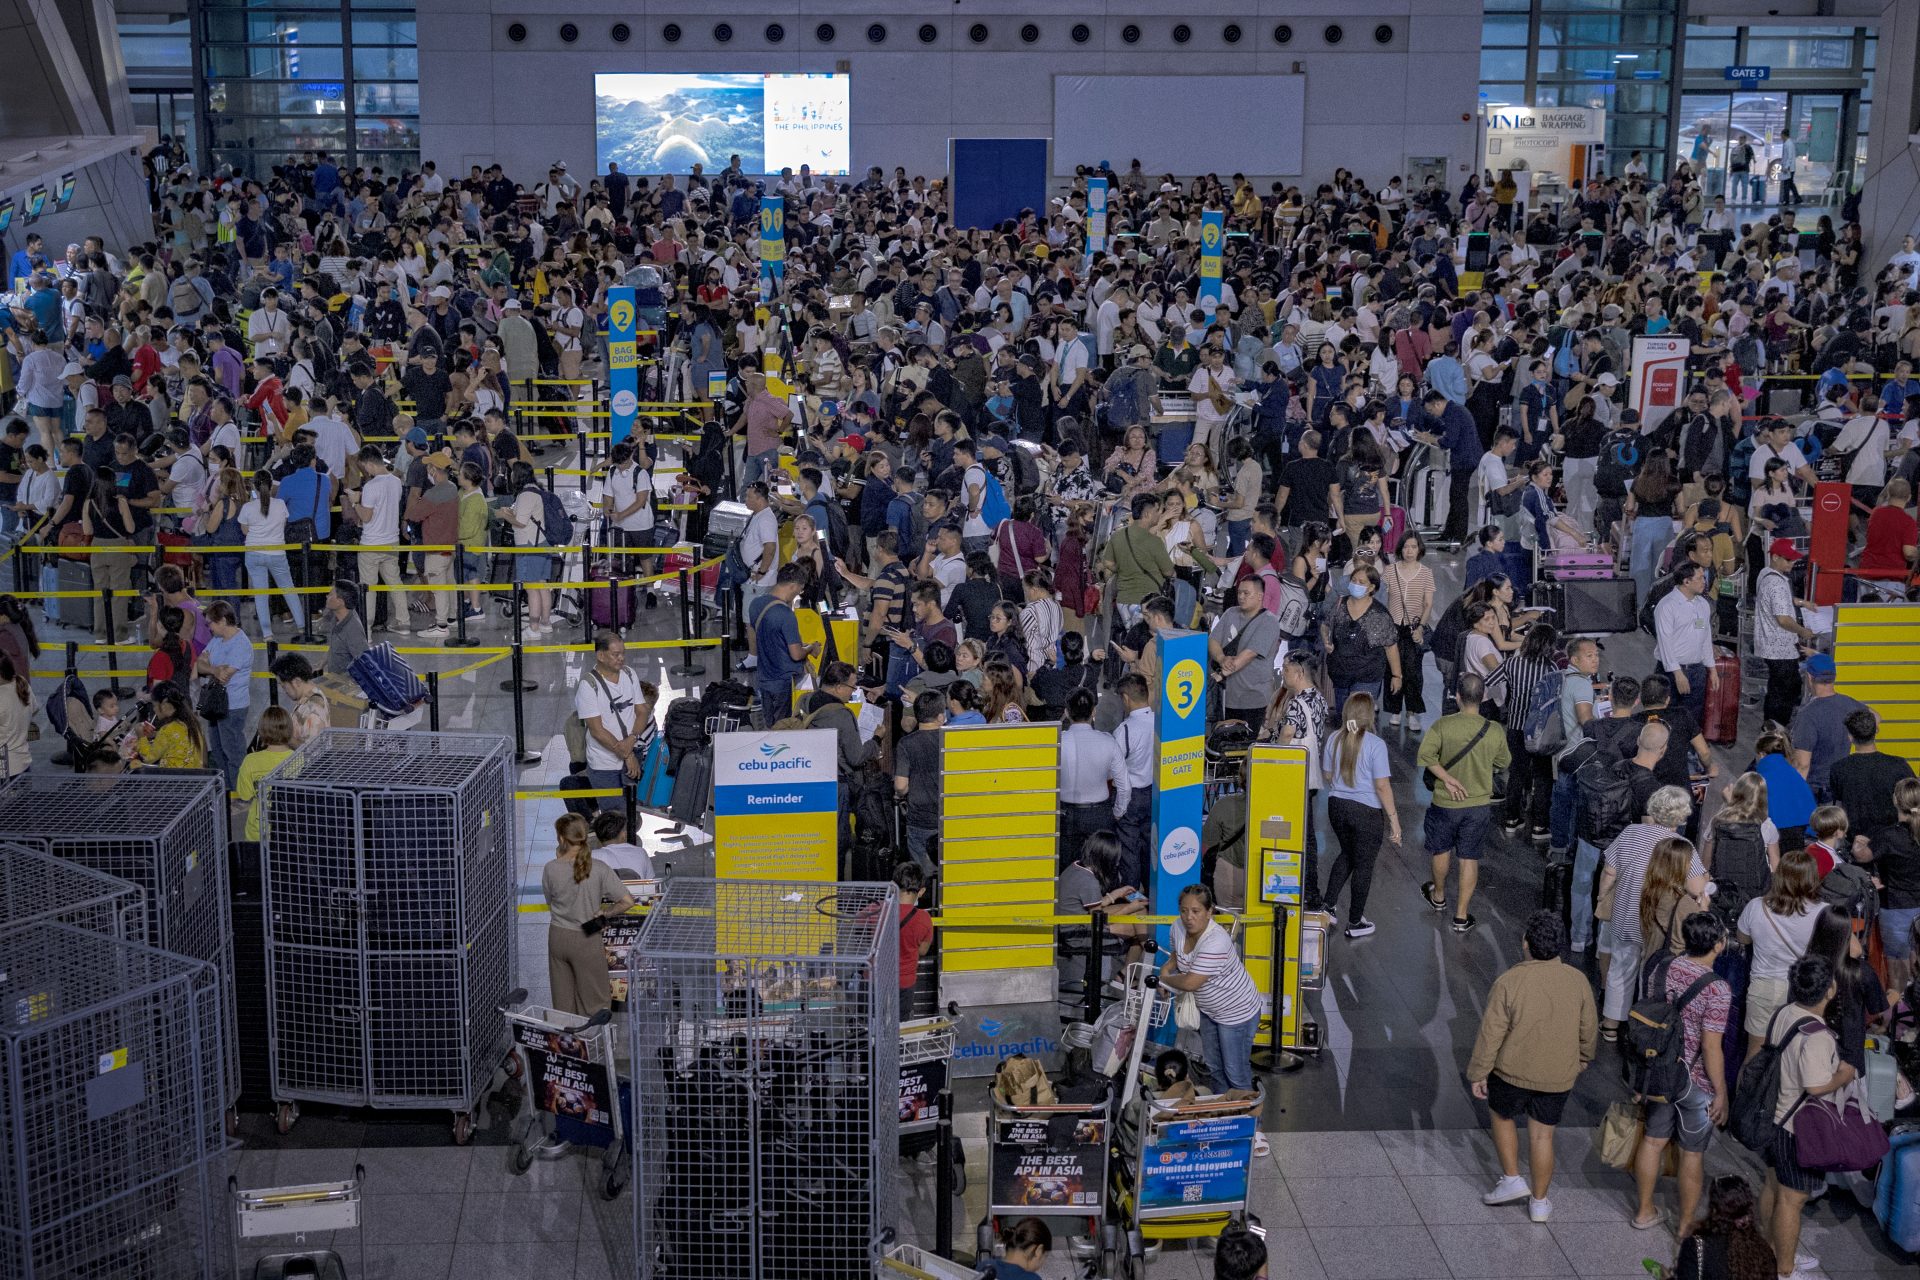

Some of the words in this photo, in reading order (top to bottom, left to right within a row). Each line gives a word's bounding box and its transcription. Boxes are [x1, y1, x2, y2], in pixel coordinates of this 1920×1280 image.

[1731, 68, 1756, 78] GATE
[1758, 68, 1765, 78] 3
[1542, 114, 1586, 122] BAGGAGE
[775, 123, 789, 131] THE
[792, 123, 843, 131] PHILIPPINES
[1540, 121, 1586, 129] WRAPPING
[1207, 233, 1215, 245] 2
[617, 311, 628, 327] 2
[614, 346, 632, 355] BAG
[612, 355, 635, 364] DROP
[677, 554, 694, 563] Trave
[1177, 669, 1193, 679] Step
[1177, 681, 1193, 709] 3
[1162, 750, 1203, 765] BOARDING
[738, 759, 768, 771] cebu
[770, 757, 811, 772] pacific
[1172, 764, 1192, 775] GATE
[747, 793, 804, 805] Reminder
[1164, 851, 1177, 860] cebu
[1177, 847, 1196, 859] pacific
[953, 1040, 994, 1059] cebu
[545, 1063, 563, 1076] THE
[564, 1068, 588, 1082] BEST
[543, 1072, 559, 1083] API
[560, 1077, 571, 1087] IN
[572, 1080, 595, 1093] ASIA
[899, 1075, 923, 1087] BEST
[903, 1083, 927, 1096] ASIA
[1180, 1126, 1208, 1135] Unlimited
[1209, 1124, 1239, 1132] Enjoyment
[1020, 1155, 1042, 1165] THE
[1045, 1155, 1077, 1165] BEST
[1014, 1166, 1036, 1176] API
[1038, 1166, 1051, 1175] IN
[1054, 1166, 1083, 1175] ASIA
[1146, 1163, 1192, 1175] Unlimited
[1194, 1160, 1243, 1172] Enjoyment
